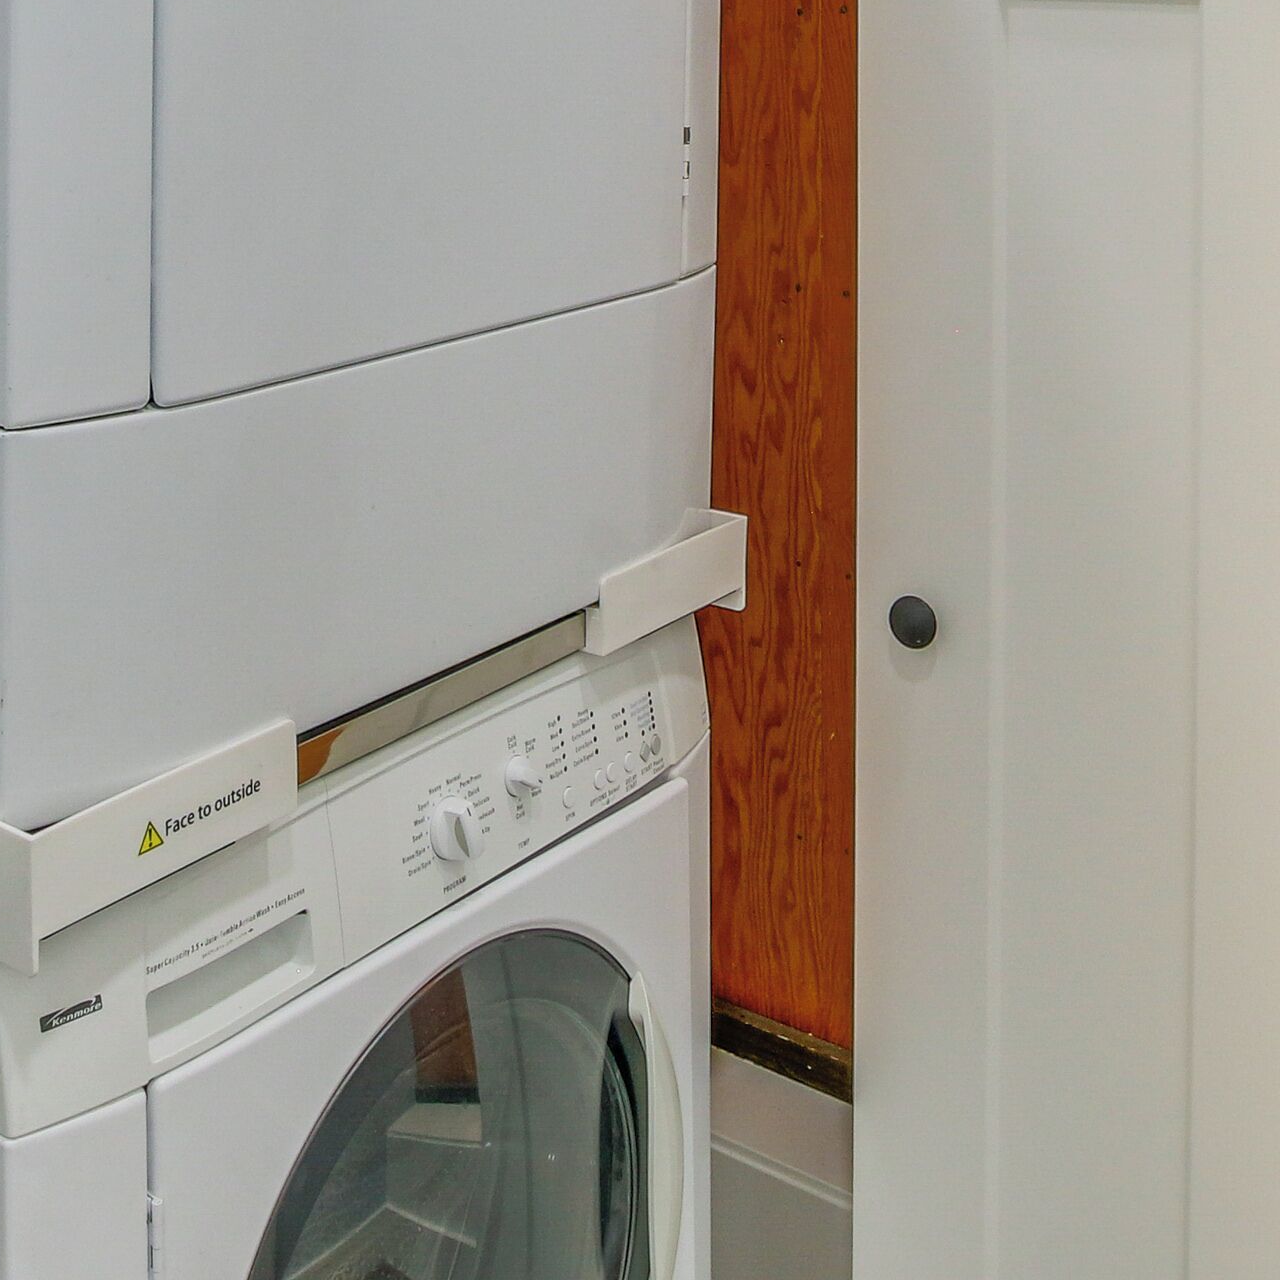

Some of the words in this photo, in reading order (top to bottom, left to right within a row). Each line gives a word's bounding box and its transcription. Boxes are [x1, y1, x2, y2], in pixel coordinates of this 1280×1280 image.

[164, 812, 195, 837] Face
[198, 804, 212, 820] to
[214, 778, 261, 812] outside
[443, 875, 467, 894] PROGRAM
[146, 961, 164, 975] Super
[287, 888, 305, 901] Access
[51, 1002, 102, 1028] Kenmore
